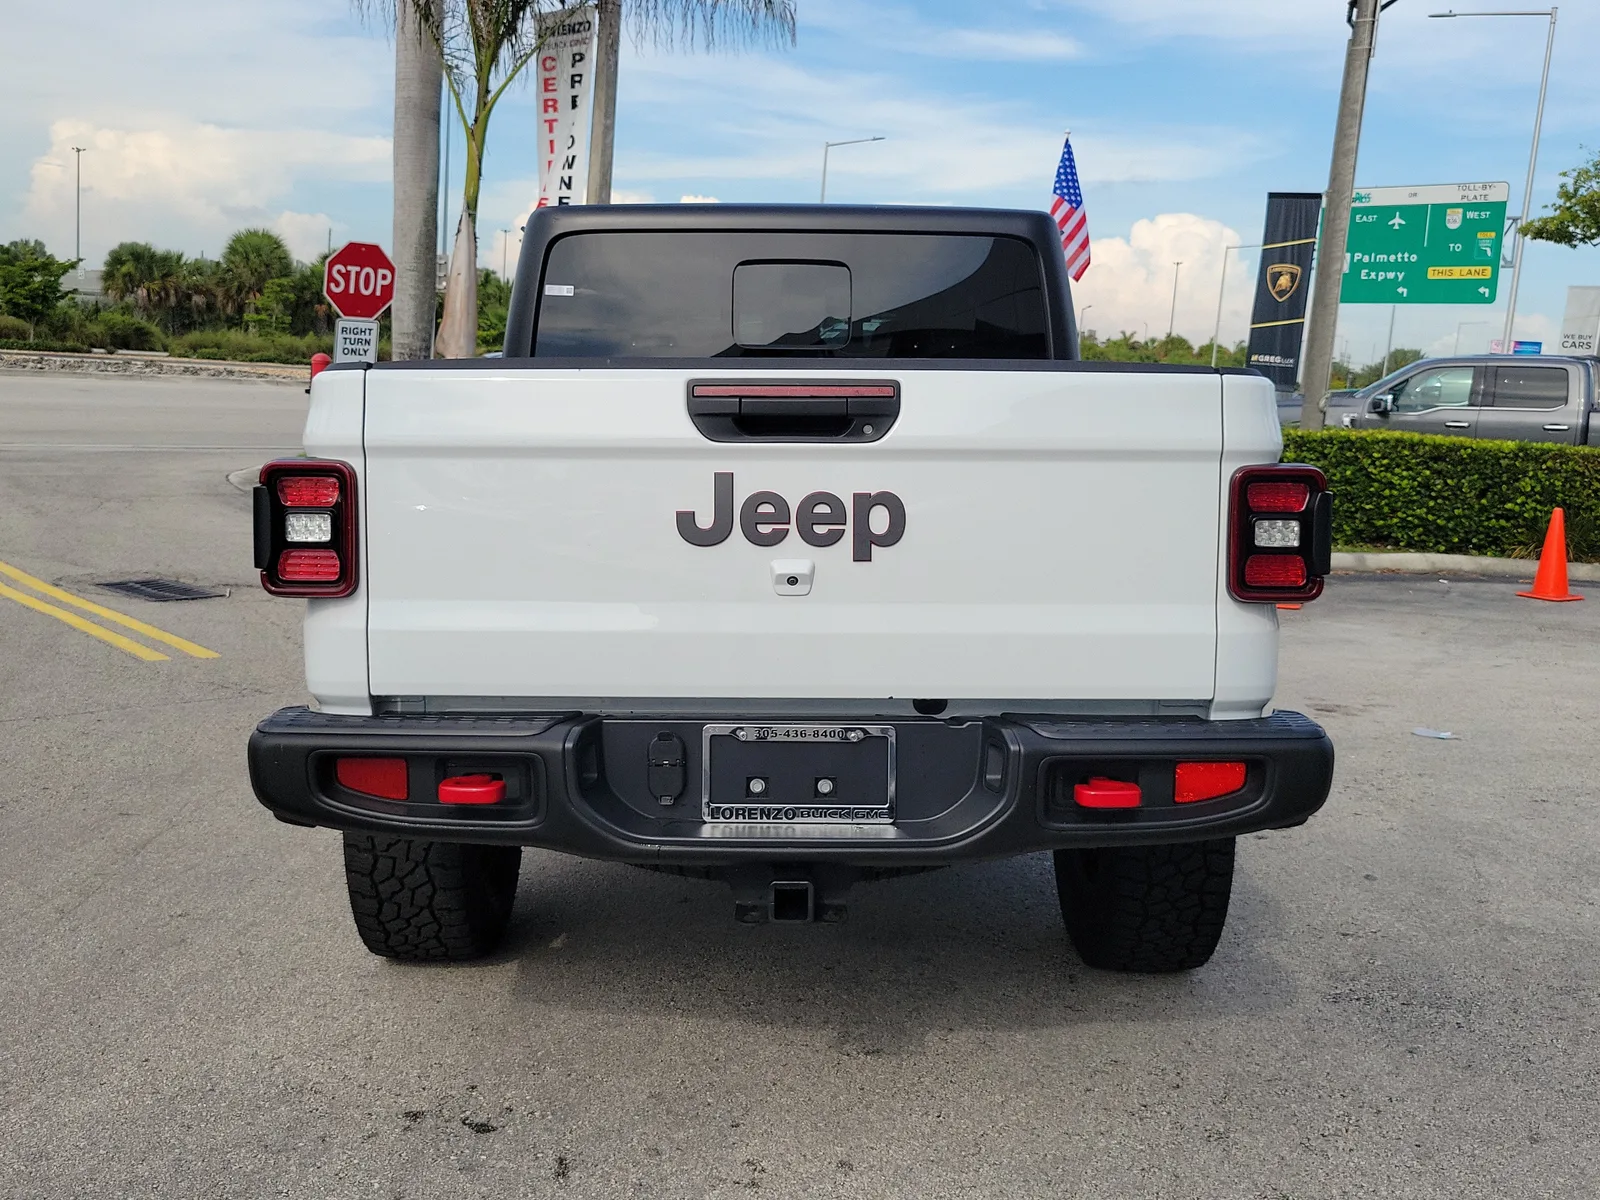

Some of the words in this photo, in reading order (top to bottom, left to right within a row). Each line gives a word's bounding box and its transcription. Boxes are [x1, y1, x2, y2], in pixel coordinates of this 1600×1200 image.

[1355, 214, 1378, 222] EAST
[1466, 211, 1491, 219] WEST
[1449, 243, 1462, 252] TO
[1353, 252, 1418, 263] Palmetto
[1360, 270, 1405, 282] Expwy
[1431, 269, 1454, 277] THIS
[1459, 268, 1488, 277] LANE
[329, 264, 393, 296] STOP
[341, 326, 374, 336] RIGHT
[342, 337, 372, 346] TURN
[1561, 340, 1592, 350] CARS
[342, 347, 369, 356] ONLY
[675, 471, 907, 563] Jeep
[754, 728, 846, 739] 305-436-8400
[710, 806, 797, 820] LORENZO
